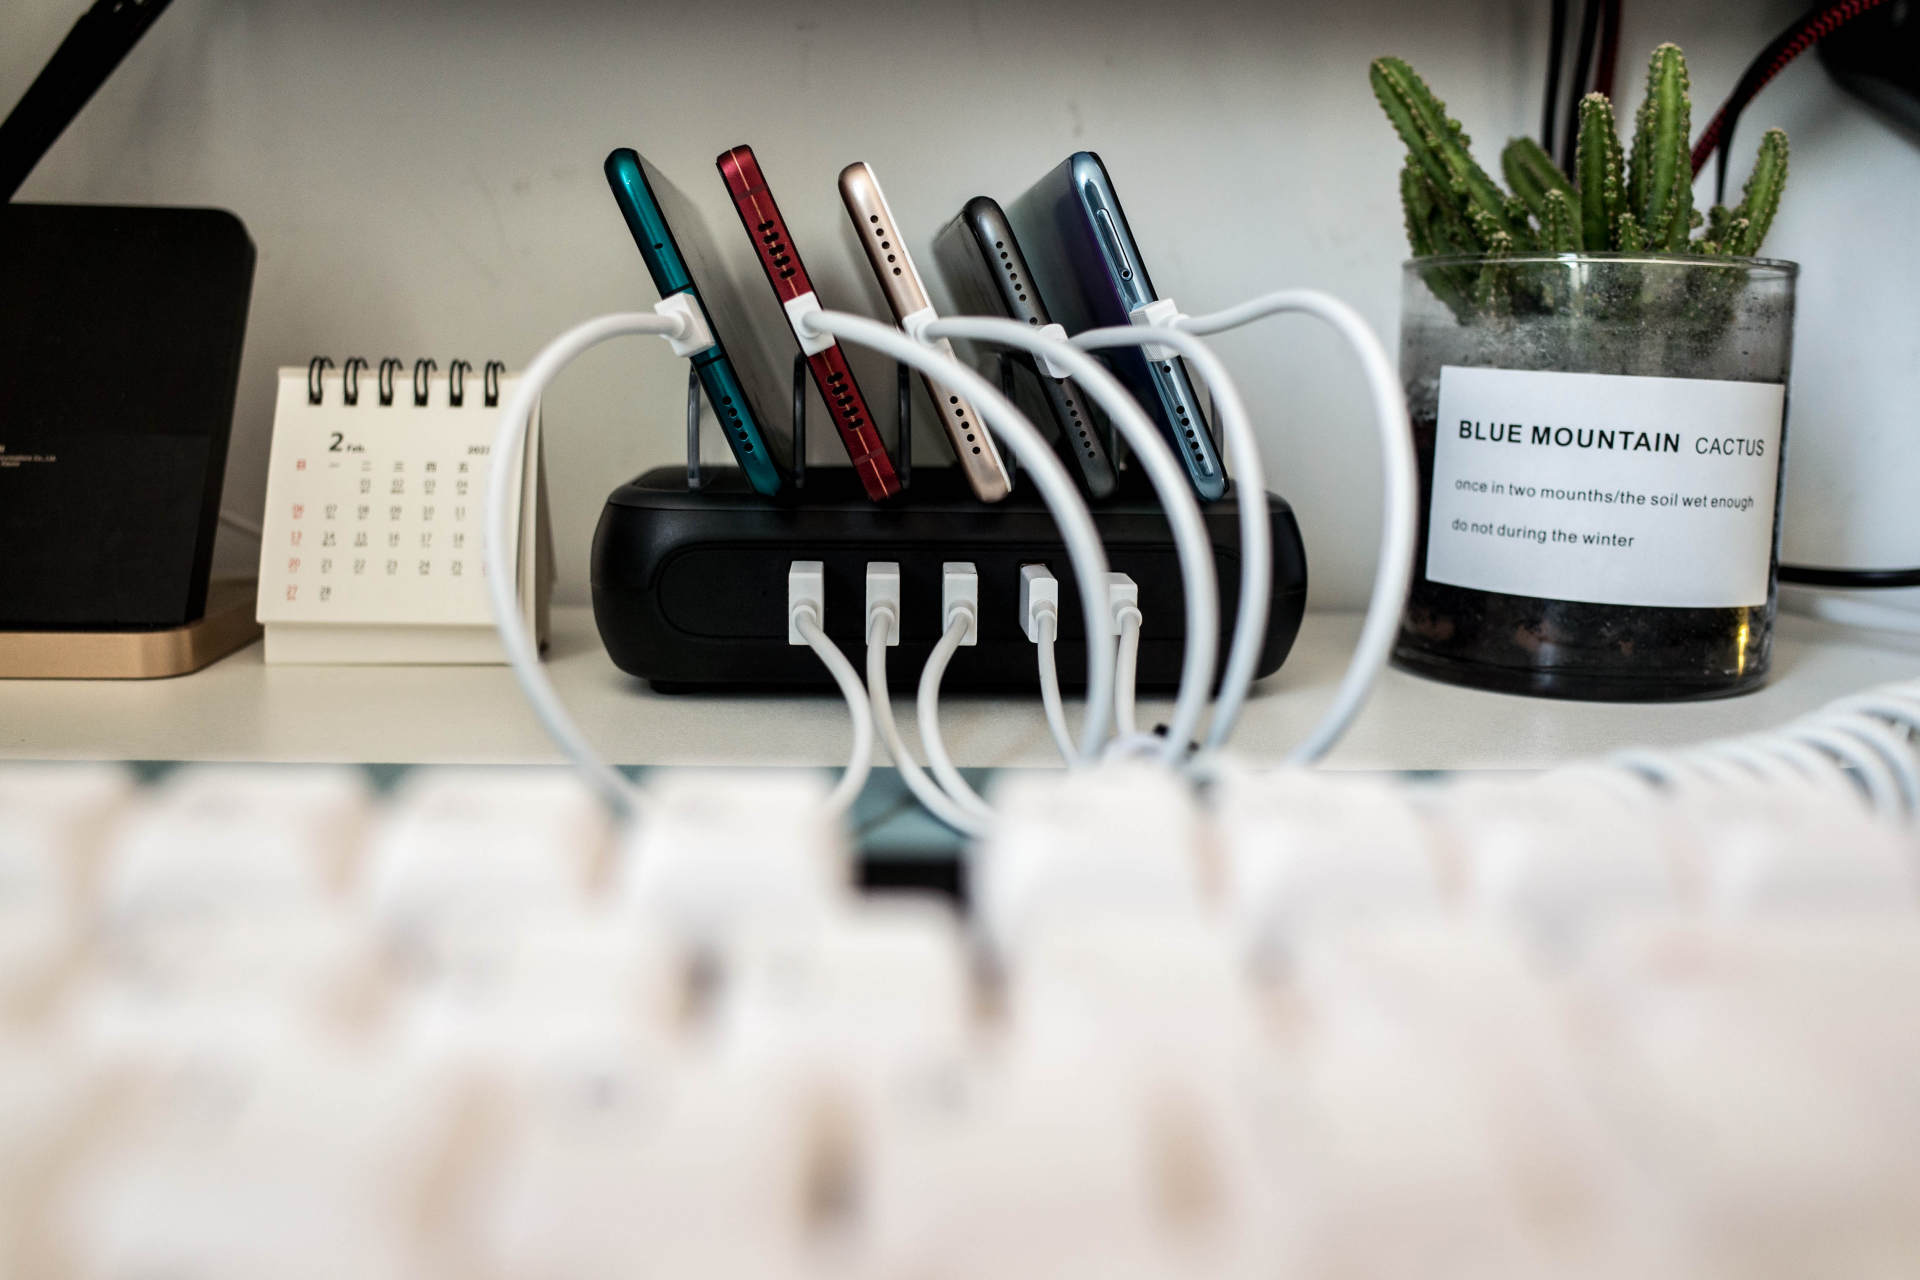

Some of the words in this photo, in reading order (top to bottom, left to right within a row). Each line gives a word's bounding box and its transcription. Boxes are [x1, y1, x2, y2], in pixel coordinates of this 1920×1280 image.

[329, 432, 344, 452] 2
[1458, 420, 1522, 443] BLUE
[1531, 425, 1681, 453] MOUNTAIN
[1695, 437, 1765, 457] CACTUS
[1455, 478, 1488, 494] once
[1491, 481, 1504, 495] in
[1508, 483, 1536, 498] two
[1540, 486, 1646, 506] mounths/the
[1650, 492, 1678, 507] soil
[1682, 495, 1708, 508] wet
[1710, 496, 1754, 511] enough
[1452, 518, 1468, 533] do
[1471, 522, 1494, 535] not
[1497, 524, 1547, 544] during
[1552, 528, 1577, 544] the
[1583, 532, 1635, 547] winter
